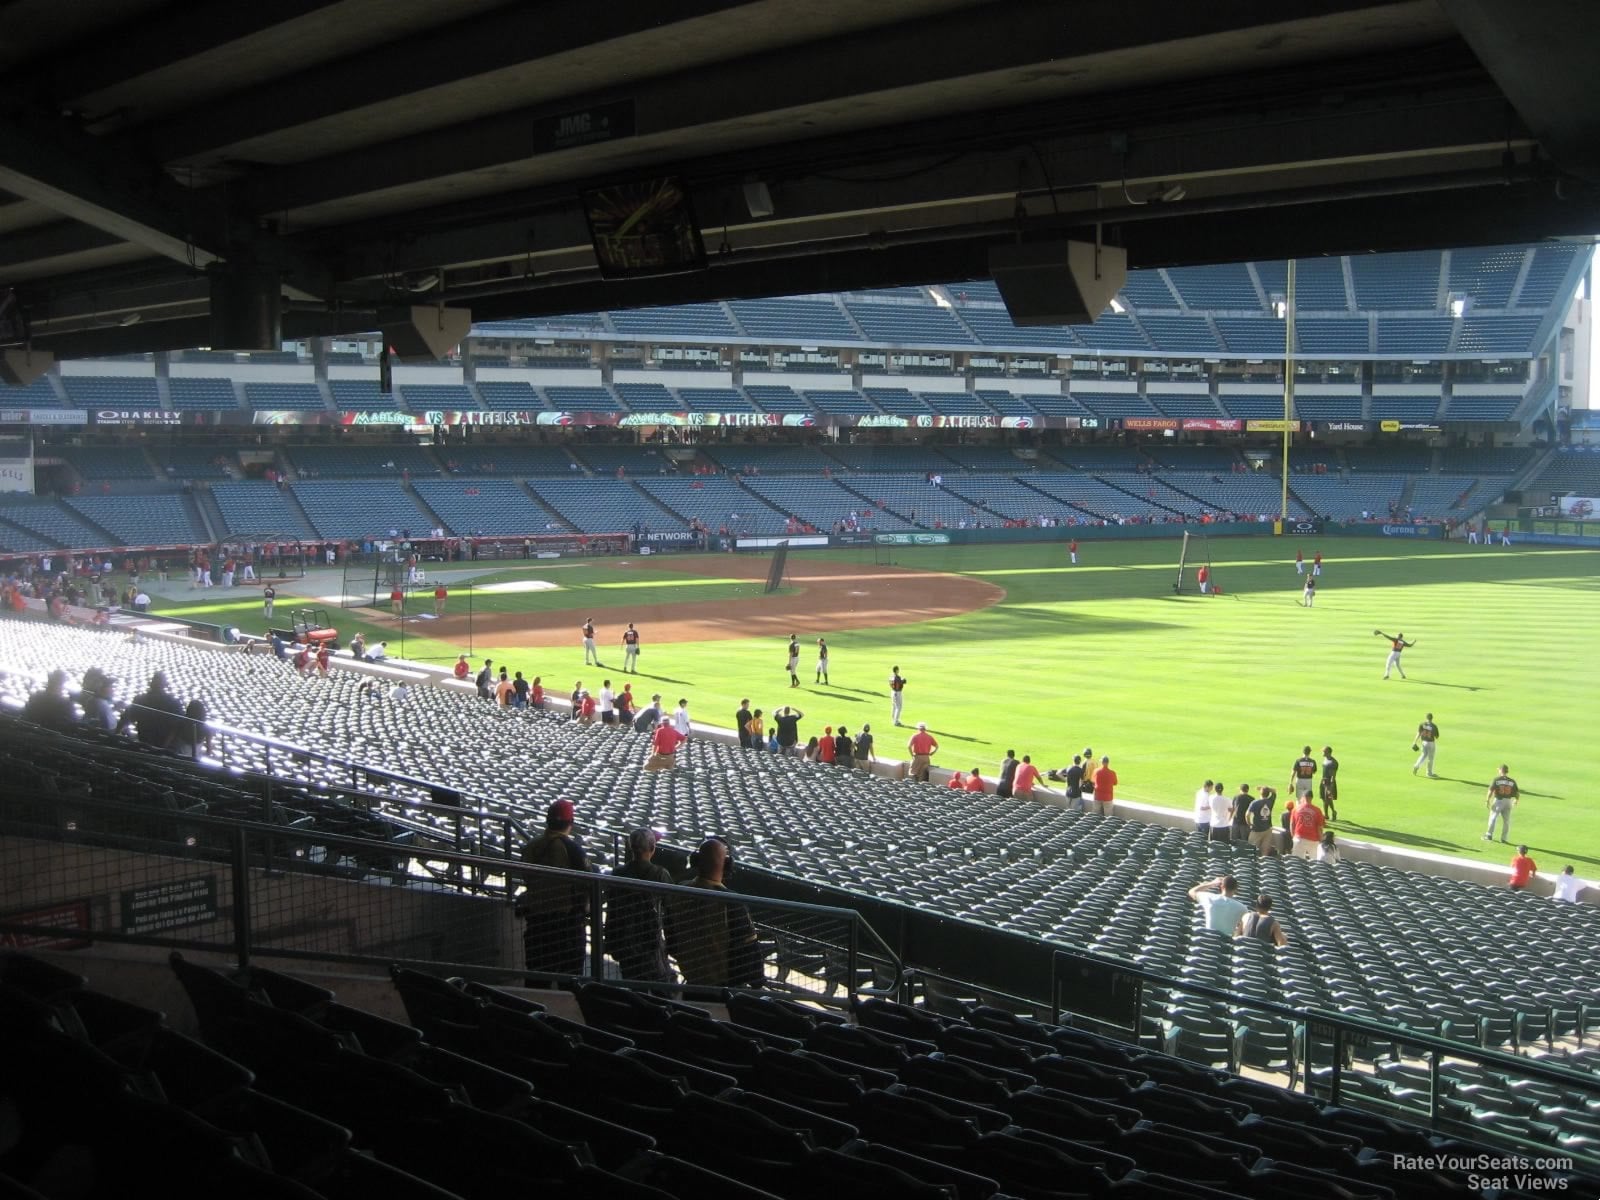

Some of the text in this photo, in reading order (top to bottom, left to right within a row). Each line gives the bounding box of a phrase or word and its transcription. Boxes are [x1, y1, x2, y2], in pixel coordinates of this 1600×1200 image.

[554, 112, 591, 137] JMG
[121, 411, 181, 420] OAKLEY
[429, 412, 442, 423] VS
[460, 411, 515, 425] ANGELS
[690, 413, 703, 424] VS
[719, 413, 768, 426] ANGELS
[920, 415, 932, 426] VS
[1127, 419, 1177, 429] WELLS FARGO
[1328, 422, 1363, 431] Yard House
[1382, 524, 1415, 536] Corona
[647, 532, 693, 542] NETWORK
